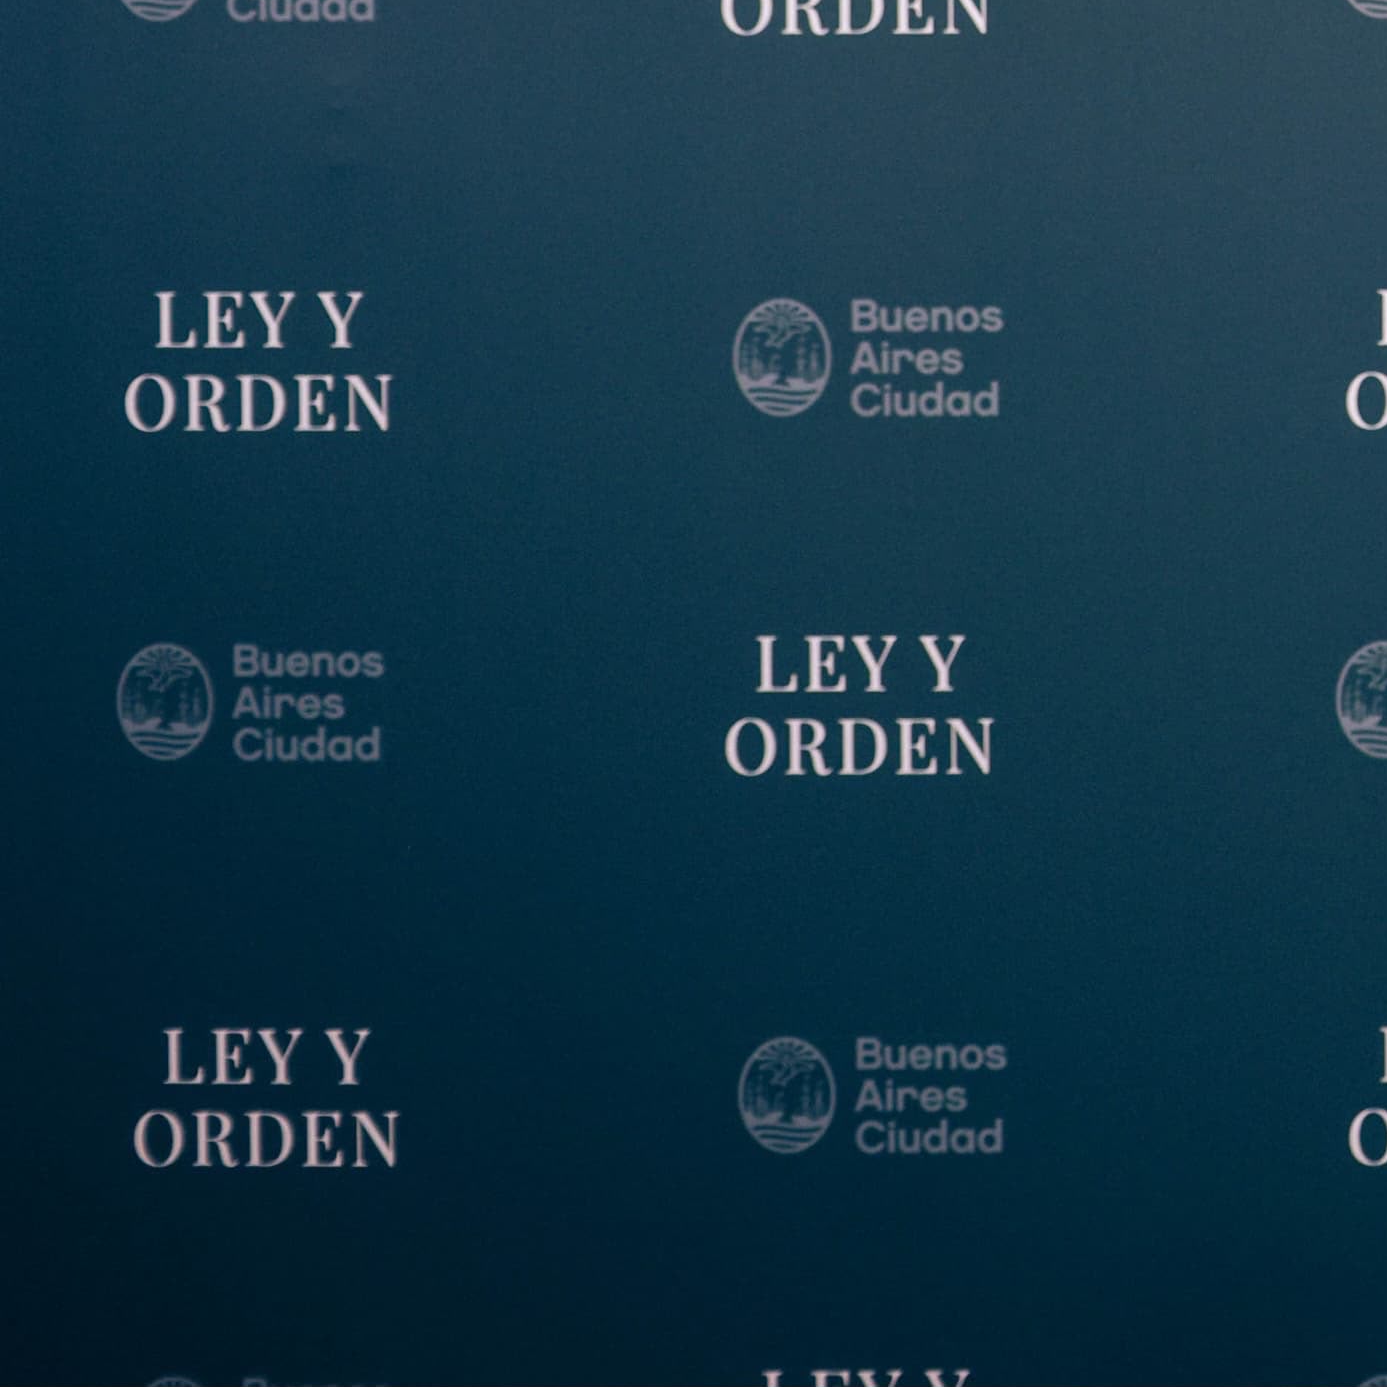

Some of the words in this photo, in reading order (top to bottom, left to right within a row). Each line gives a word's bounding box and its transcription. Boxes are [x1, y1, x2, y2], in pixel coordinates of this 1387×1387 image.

[154, 290, 297, 349] LEY
[316, 290, 365, 349] Y
[851, 298, 1004, 333] Buenos
[850, 341, 964, 374] Aires
[124, 373, 393, 433] ORDEN
[850, 380, 1000, 418] Ciudad
[233, 643, 385, 678] Buenos
[755, 634, 898, 693] LEY
[918, 633, 966, 693] Y
[233, 686, 345, 719] Aires
[233, 726, 381, 762] Ciudad
[724, 716, 995, 777] ORDEN
[163, 1027, 304, 1086] LEY
[324, 1027, 371, 1086] Y
[856, 1036, 1007, 1070] Buenos
[855, 1079, 968, 1112] Aires
[133, 1109, 400, 1168] ORDEN
[855, 1118, 1003, 1154] Ciudad
